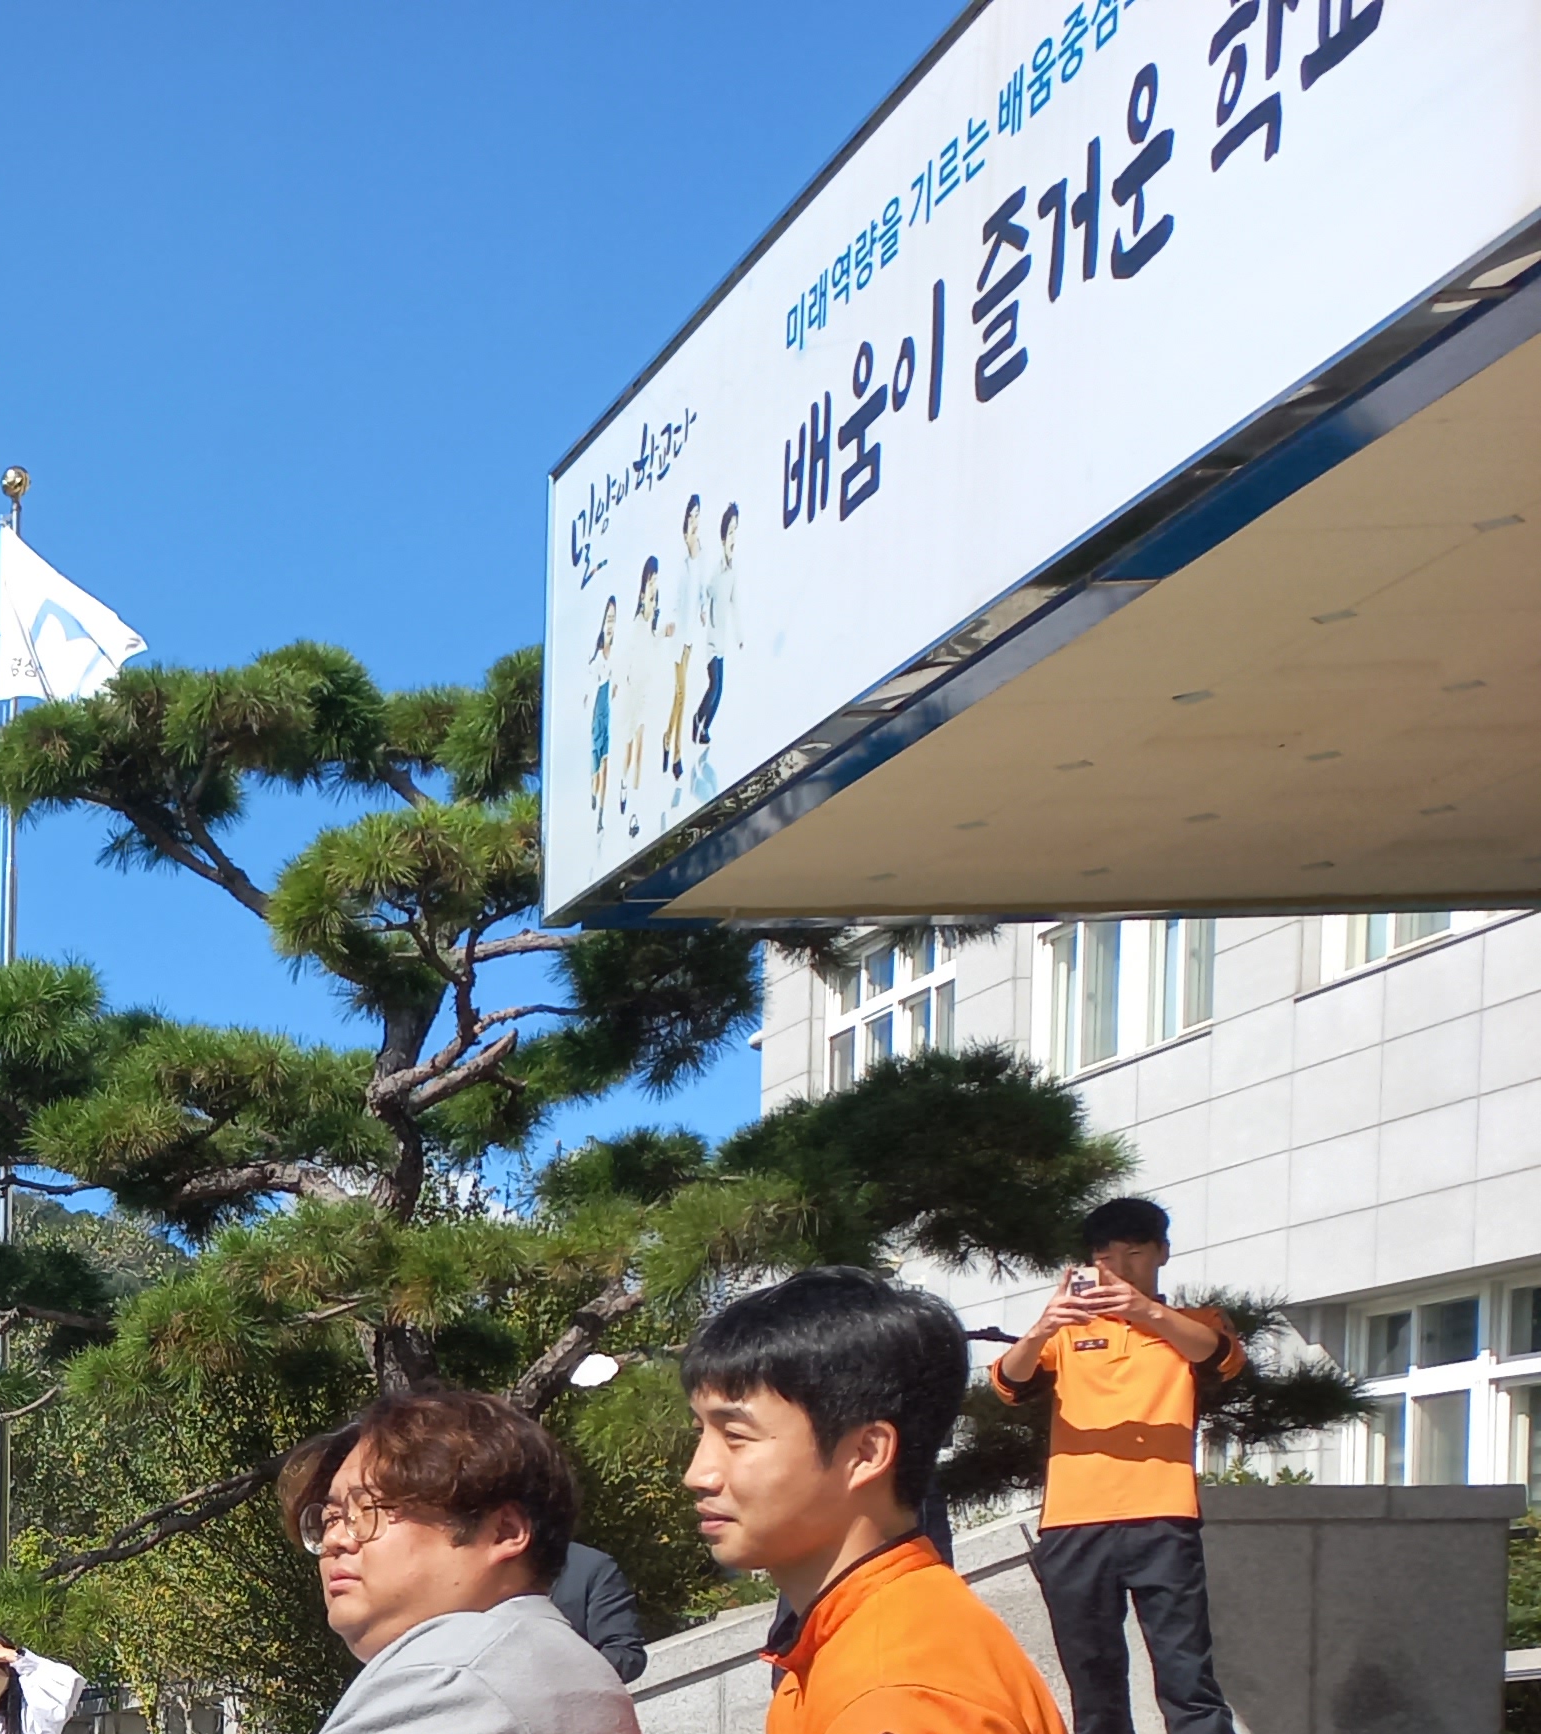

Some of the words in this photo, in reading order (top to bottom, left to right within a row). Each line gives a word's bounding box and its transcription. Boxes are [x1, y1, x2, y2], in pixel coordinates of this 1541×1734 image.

[782, 277, 945, 530] 배움이
[971, 62, 1175, 402] 즐거운
[786, 196, 903, 351] 미래역량을
[909, 117, 990, 227] 기르는
